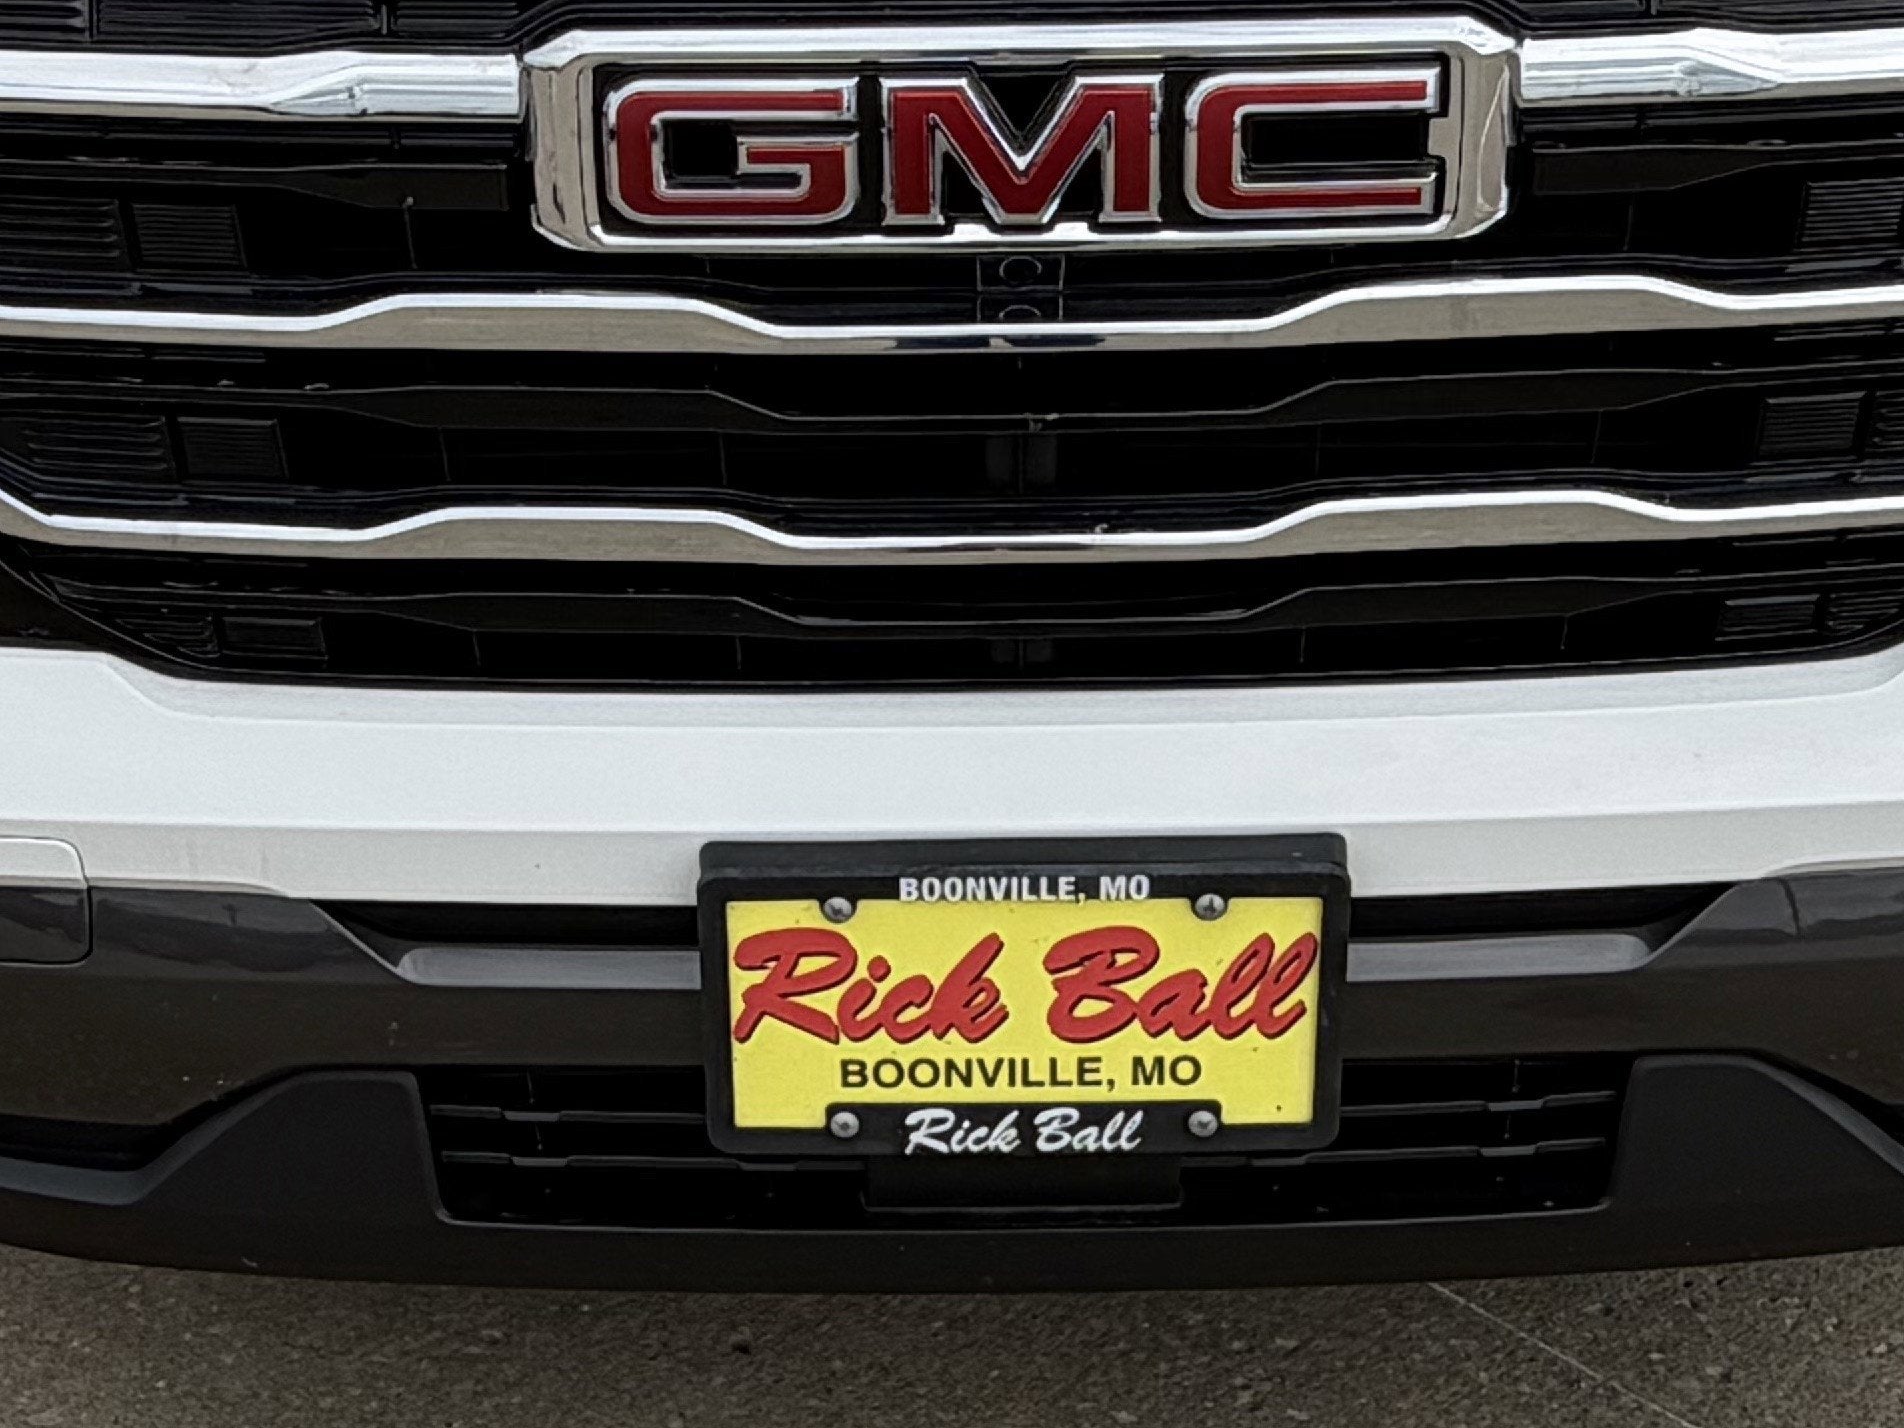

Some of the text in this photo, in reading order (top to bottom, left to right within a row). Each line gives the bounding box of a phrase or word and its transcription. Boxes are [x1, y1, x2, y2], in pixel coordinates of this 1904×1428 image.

[606, 71, 1439, 225] GMC
[899, 874, 1150, 905] BOONVILLE, MO
[733, 925, 1318, 1044] Rick Ball
[840, 1054, 1202, 1091] BOONVILLE, MO
[904, 1107, 1141, 1155] Rick Ball
